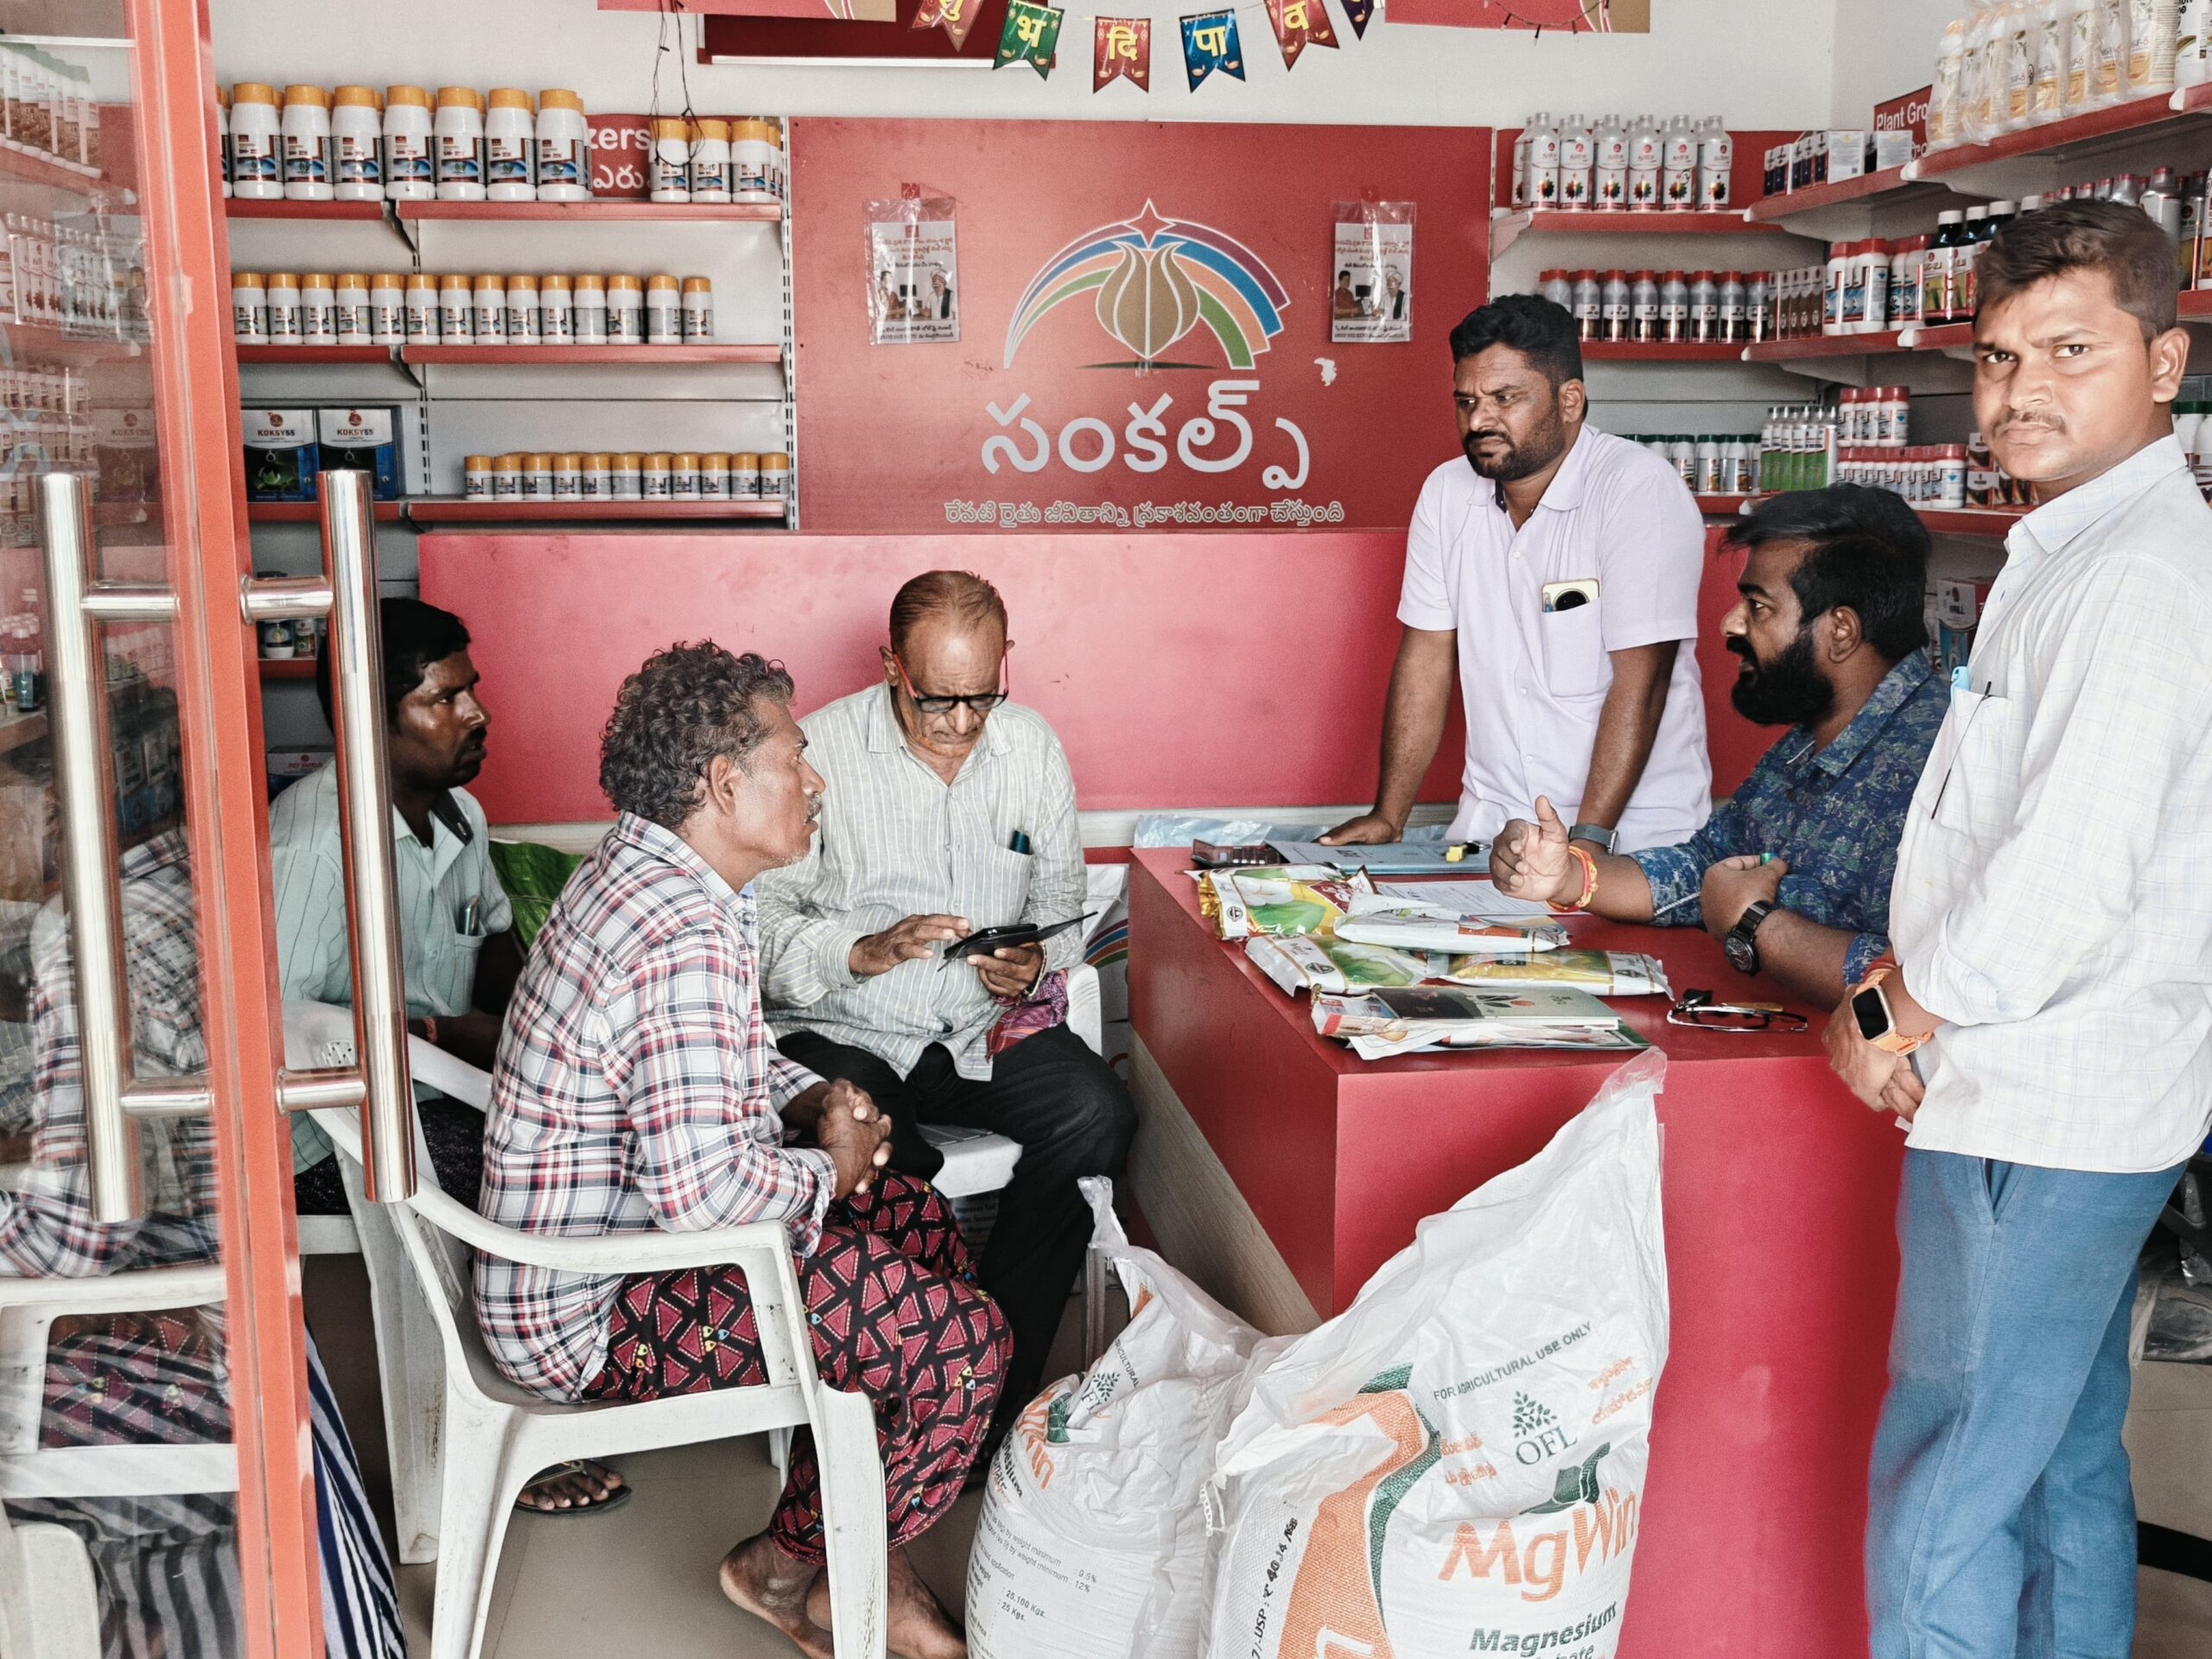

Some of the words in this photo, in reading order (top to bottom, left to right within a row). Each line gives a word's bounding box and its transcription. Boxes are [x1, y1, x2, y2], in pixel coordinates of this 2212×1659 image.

[1876, 106, 1906, 130] Plant
[1433, 1387, 1457, 1402] FOR
[1458, 1354, 1536, 1395] AGRICULTURAL
[1535, 1340, 1562, 1360] USE
[1562, 1320, 1592, 1345] ONLY
[1515, 1425, 1579, 1466] OFL
[1031, 1547, 1063, 1567] minimum
[1437, 1485, 1637, 1604] MgWin
[1037, 1562, 1070, 1584] minimum
[1075, 1580, 1091, 1594] 12%
[1468, 1600, 1618, 1658] Magnesium
